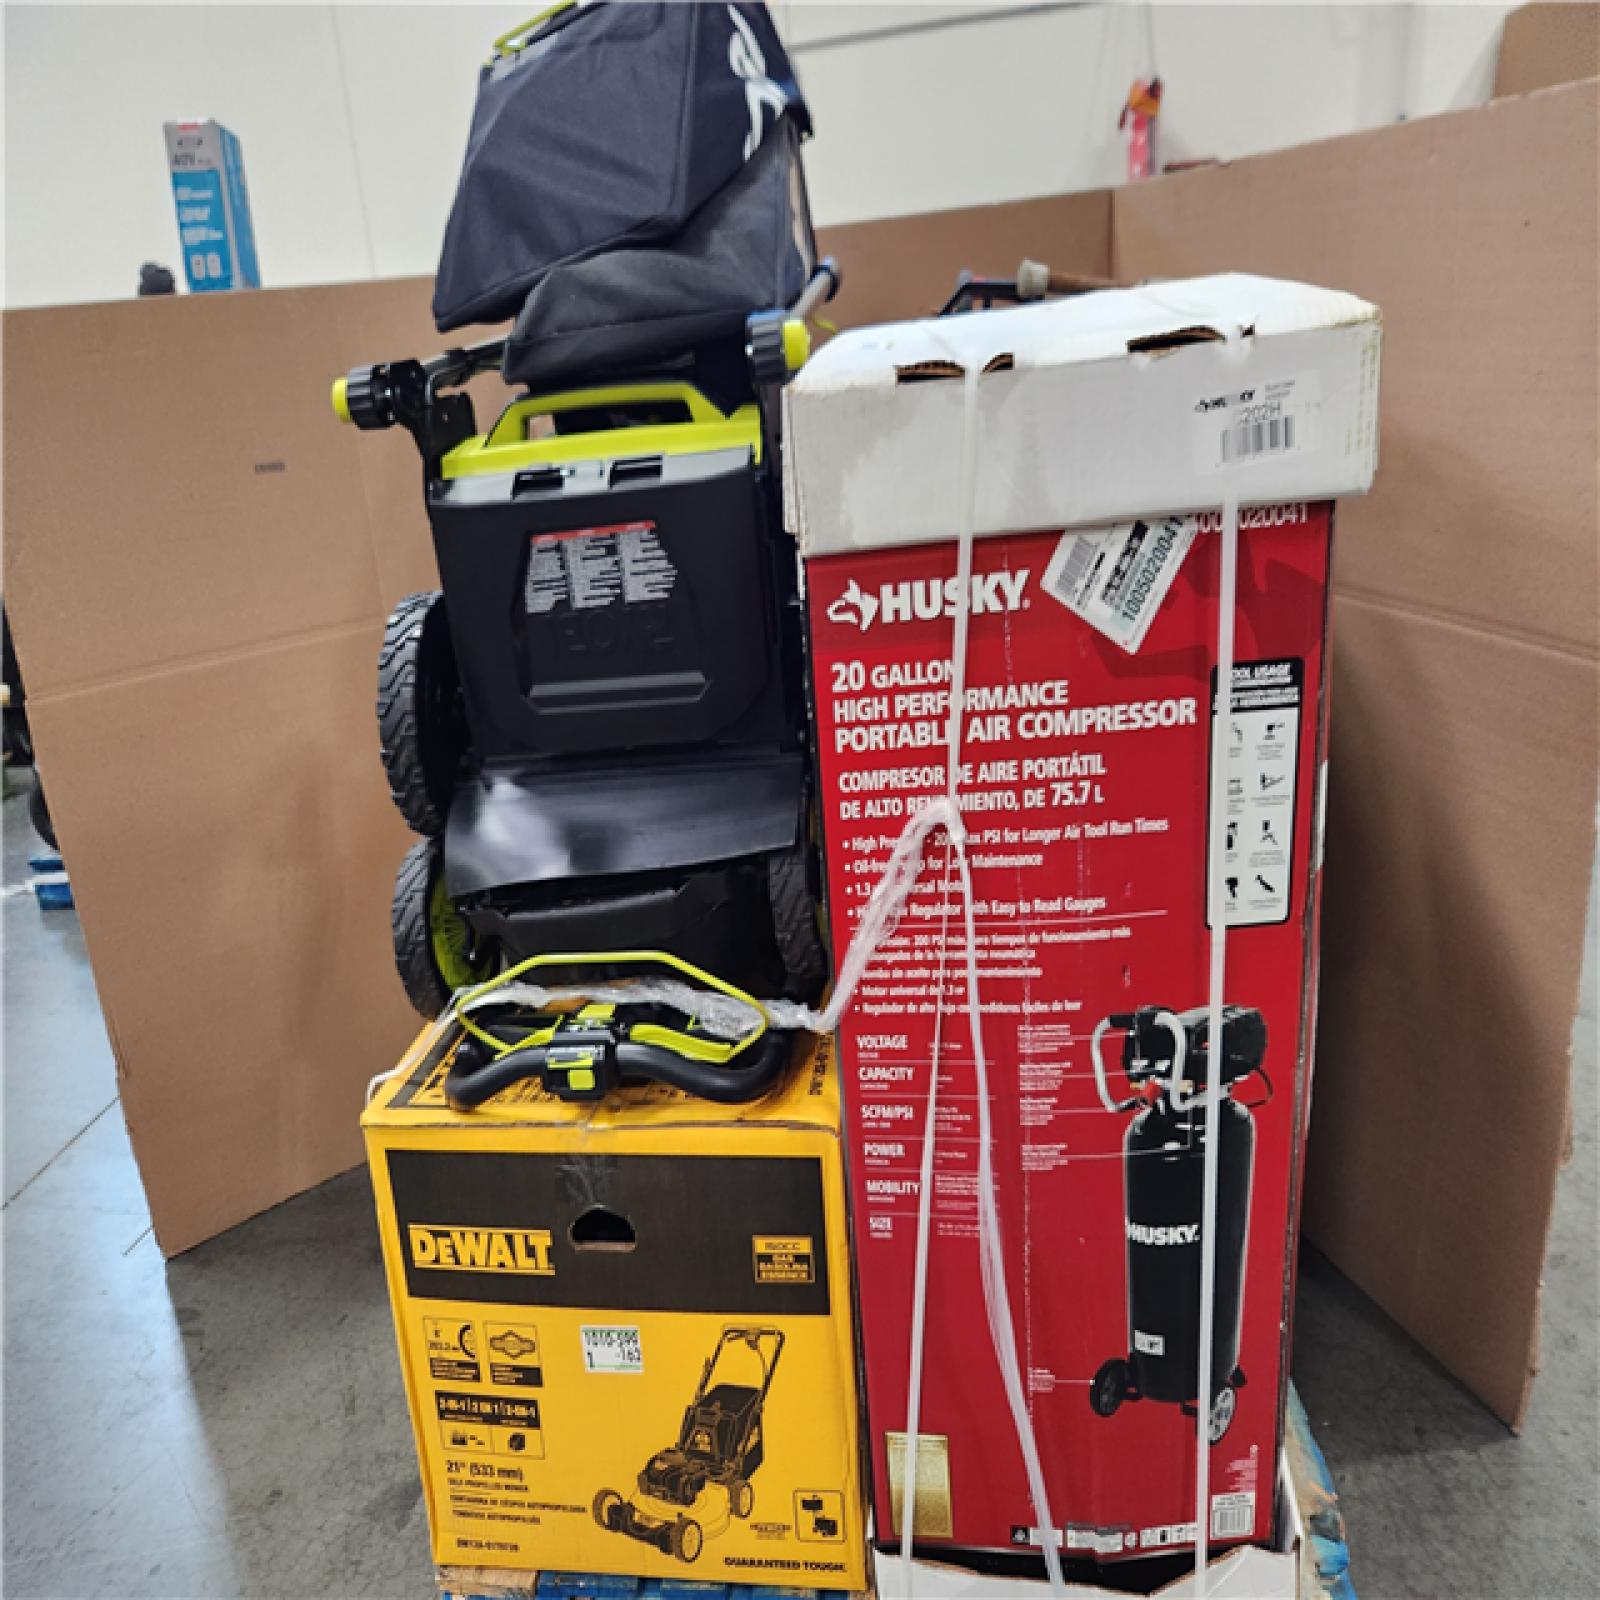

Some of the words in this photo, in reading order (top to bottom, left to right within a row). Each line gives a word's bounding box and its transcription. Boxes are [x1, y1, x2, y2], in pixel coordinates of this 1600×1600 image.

[832, 662, 865, 692] 20
[834, 697, 888, 723] HIGH
[894, 680, 1069, 718] PERFRMANCE
[966, 714, 1010, 744] AIR
[1017, 698, 1197, 740] COMPRESSOR
[838, 765, 946, 793] COMPRESOR
[977, 759, 1019, 783] AIRE
[1022, 751, 1106, 780] PORTÁTIL
[840, 799, 861, 820] DE
[864, 796, 901, 819] ALTO
[1024, 787, 1046, 808] DE
[1051, 780, 1091, 806] 75.7
[852, 837, 878, 854] High
[1004, 827, 1020, 843] for
[1022, 827, 1062, 845] Longer
[1064, 824, 1081, 840] Air
[1084, 820, 1108, 838] Tool
[1110, 819, 1133, 836] Run
[1135, 816, 1169, 833] Times
[972, 854, 1044, 869] Maintenance
[992, 900, 1017, 918] Easy
[1019, 900, 1031, 914] to
[1034, 896, 1062, 913] Read
[1065, 896, 1107, 914] Gauges
[856, 1034, 908, 1050] VOLTAGE
[858, 1067, 915, 1081] CAPACITY
[864, 1142, 905, 1157] POWER
[866, 1180, 921, 1195] MOBILITY
